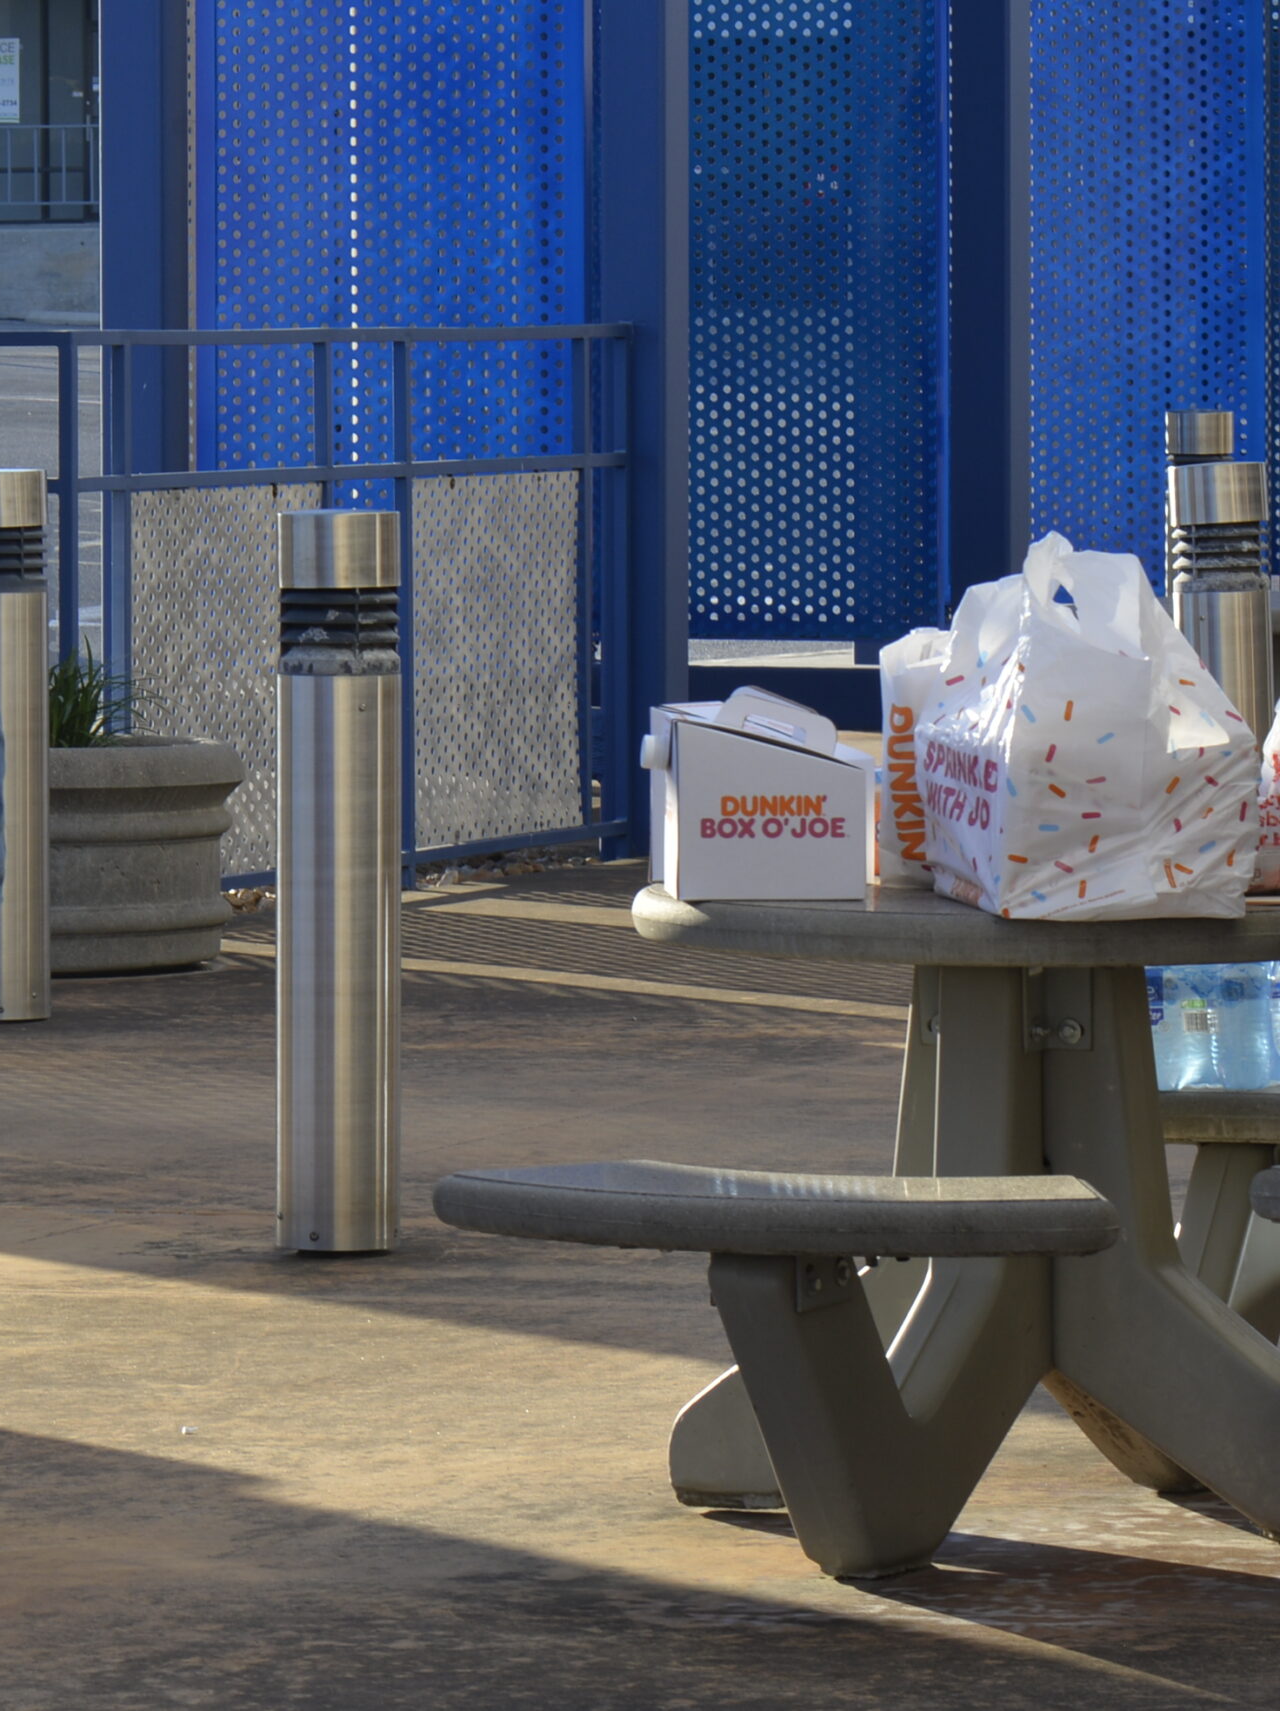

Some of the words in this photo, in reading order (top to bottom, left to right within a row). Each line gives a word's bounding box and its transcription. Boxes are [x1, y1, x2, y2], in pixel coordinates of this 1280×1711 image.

[925, 779, 967, 822] WITH
[700, 817, 756, 839] BOX
[761, 817, 846, 839] O'JOE
